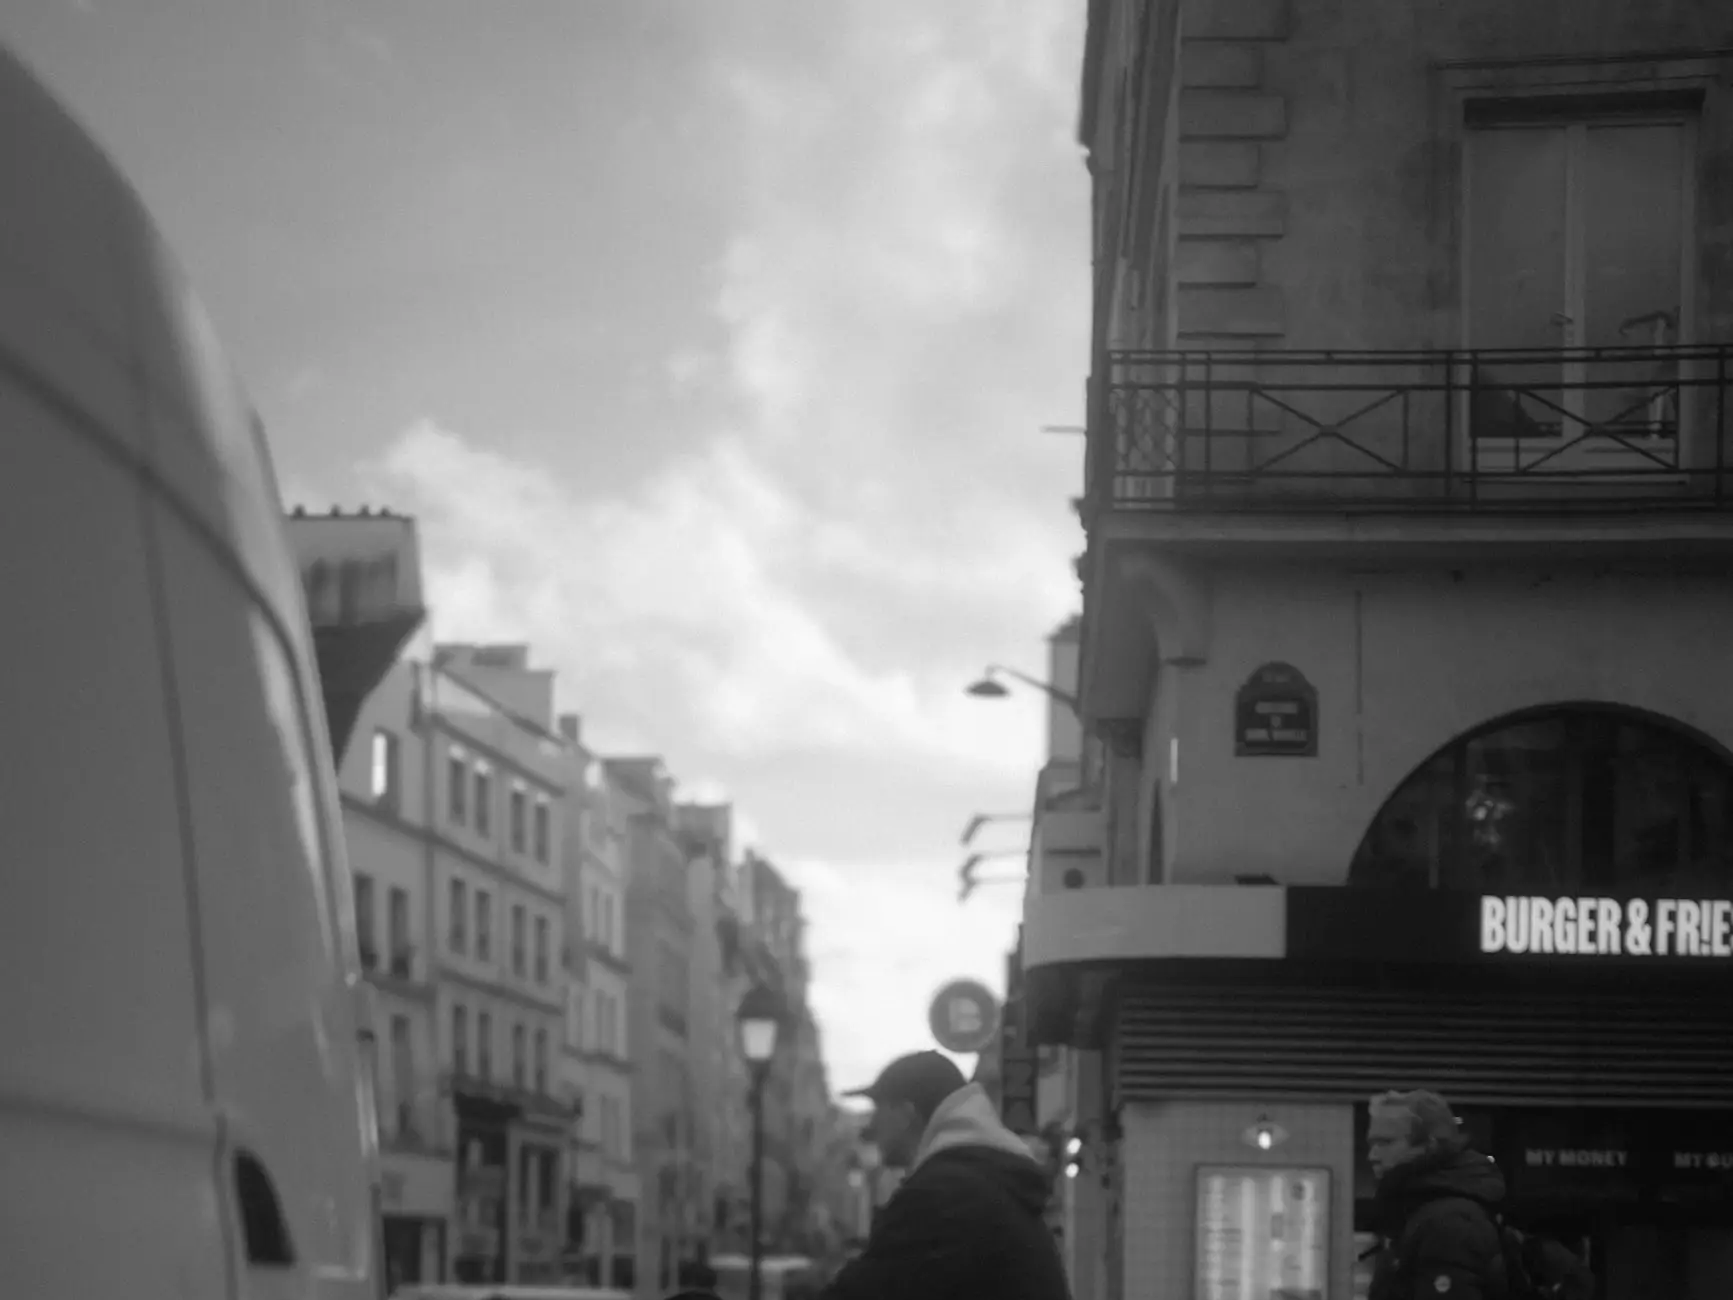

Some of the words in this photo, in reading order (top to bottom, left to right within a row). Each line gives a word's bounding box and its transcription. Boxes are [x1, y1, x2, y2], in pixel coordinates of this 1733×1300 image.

[1481, 895, 1622, 954] BURGER
[1625, 897, 1652, 956] &
[1525, 1148, 1555, 1167] MY
[1558, 1149, 1627, 1168] MONEY
